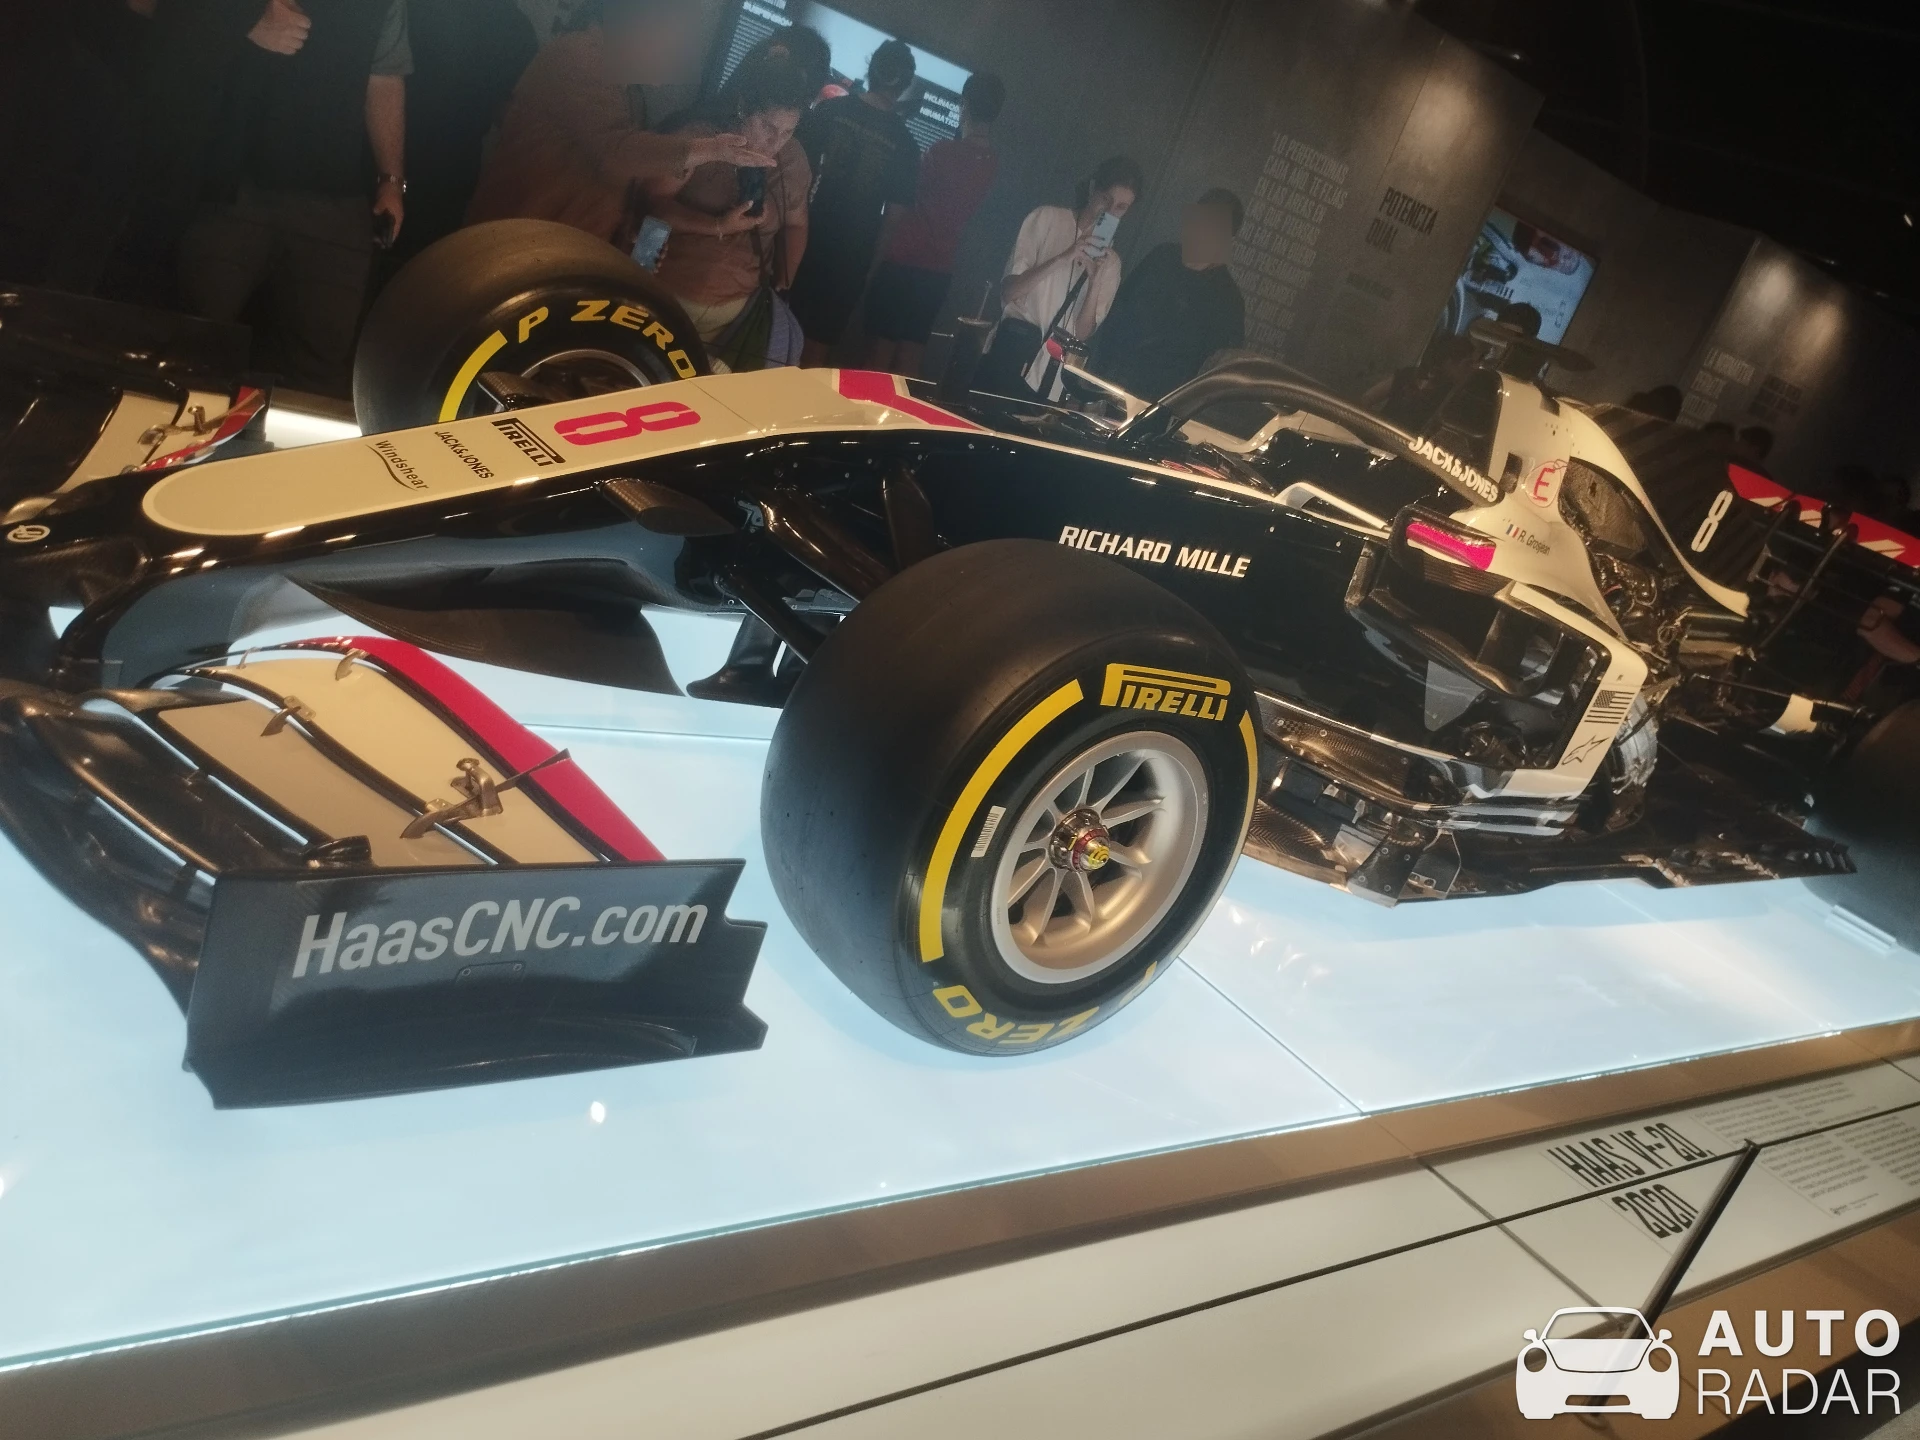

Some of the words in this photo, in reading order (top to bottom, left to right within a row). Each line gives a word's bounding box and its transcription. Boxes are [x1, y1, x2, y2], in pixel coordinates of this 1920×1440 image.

[1262, 153, 1290, 182] CADA
[1379, 187, 1439, 235] POTENCIA
[518, 306, 549, 344] P
[570, 300, 697, 379] ZERO
[491, 417, 567, 467] PIRELLI
[553, 401, 702, 446] 8
[375, 440, 429, 491] Windshear
[435, 431, 495, 480] JACK&JONES
[1408, 436, 1499, 503] JACK&JONES
[1533, 467, 1556, 501] E
[1527, 535, 1550, 555] Grosjean
[1691, 489, 1734, 552] 8
[1058, 525, 1171, 564] RICHARD
[1175, 546, 1251, 578] MILLE
[1100, 663, 1231, 721] PIRELLI
[292, 896, 709, 979] HaasCNC.com
[932, 985, 1100, 1045] ZERO
[1547, 1137, 1646, 1188] HAAS
[1611, 1184, 1699, 1239] 2020
